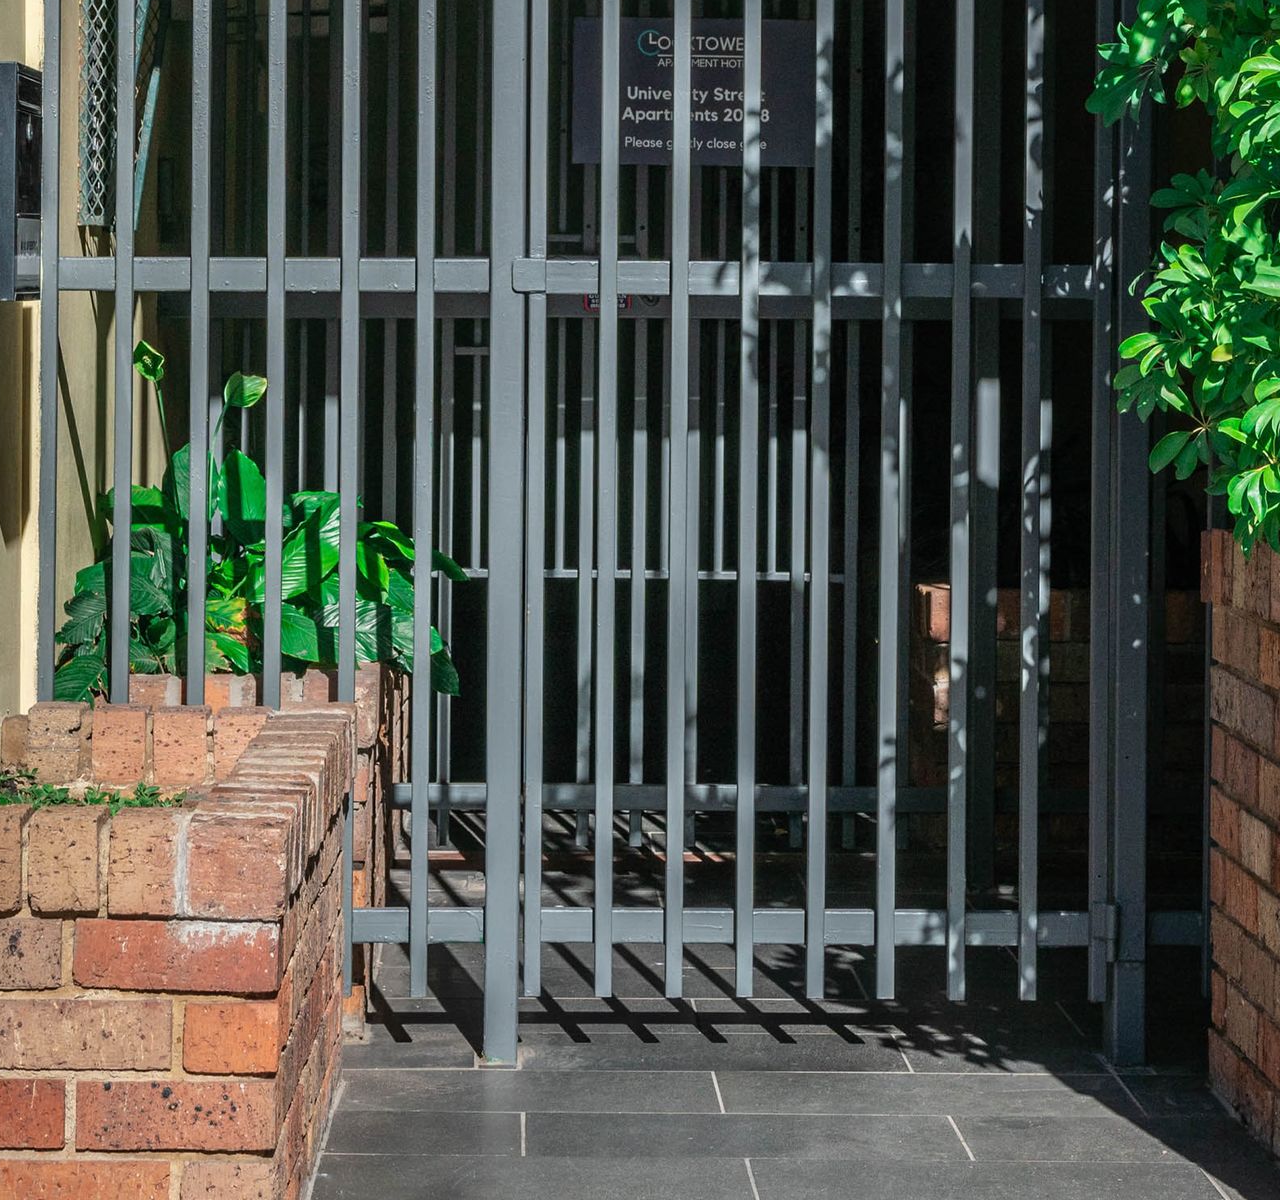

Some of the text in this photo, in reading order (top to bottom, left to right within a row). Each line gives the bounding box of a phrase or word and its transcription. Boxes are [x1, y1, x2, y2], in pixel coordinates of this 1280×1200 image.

[638, 29, 744, 56] CLOTOWE
[658, 57, 745, 69] APMENT HOT
[627, 86, 709, 104] Univety
[622, 106, 770, 124] Apartnts 208
[624, 136, 663, 148] Please
[706, 137, 737, 149] close
